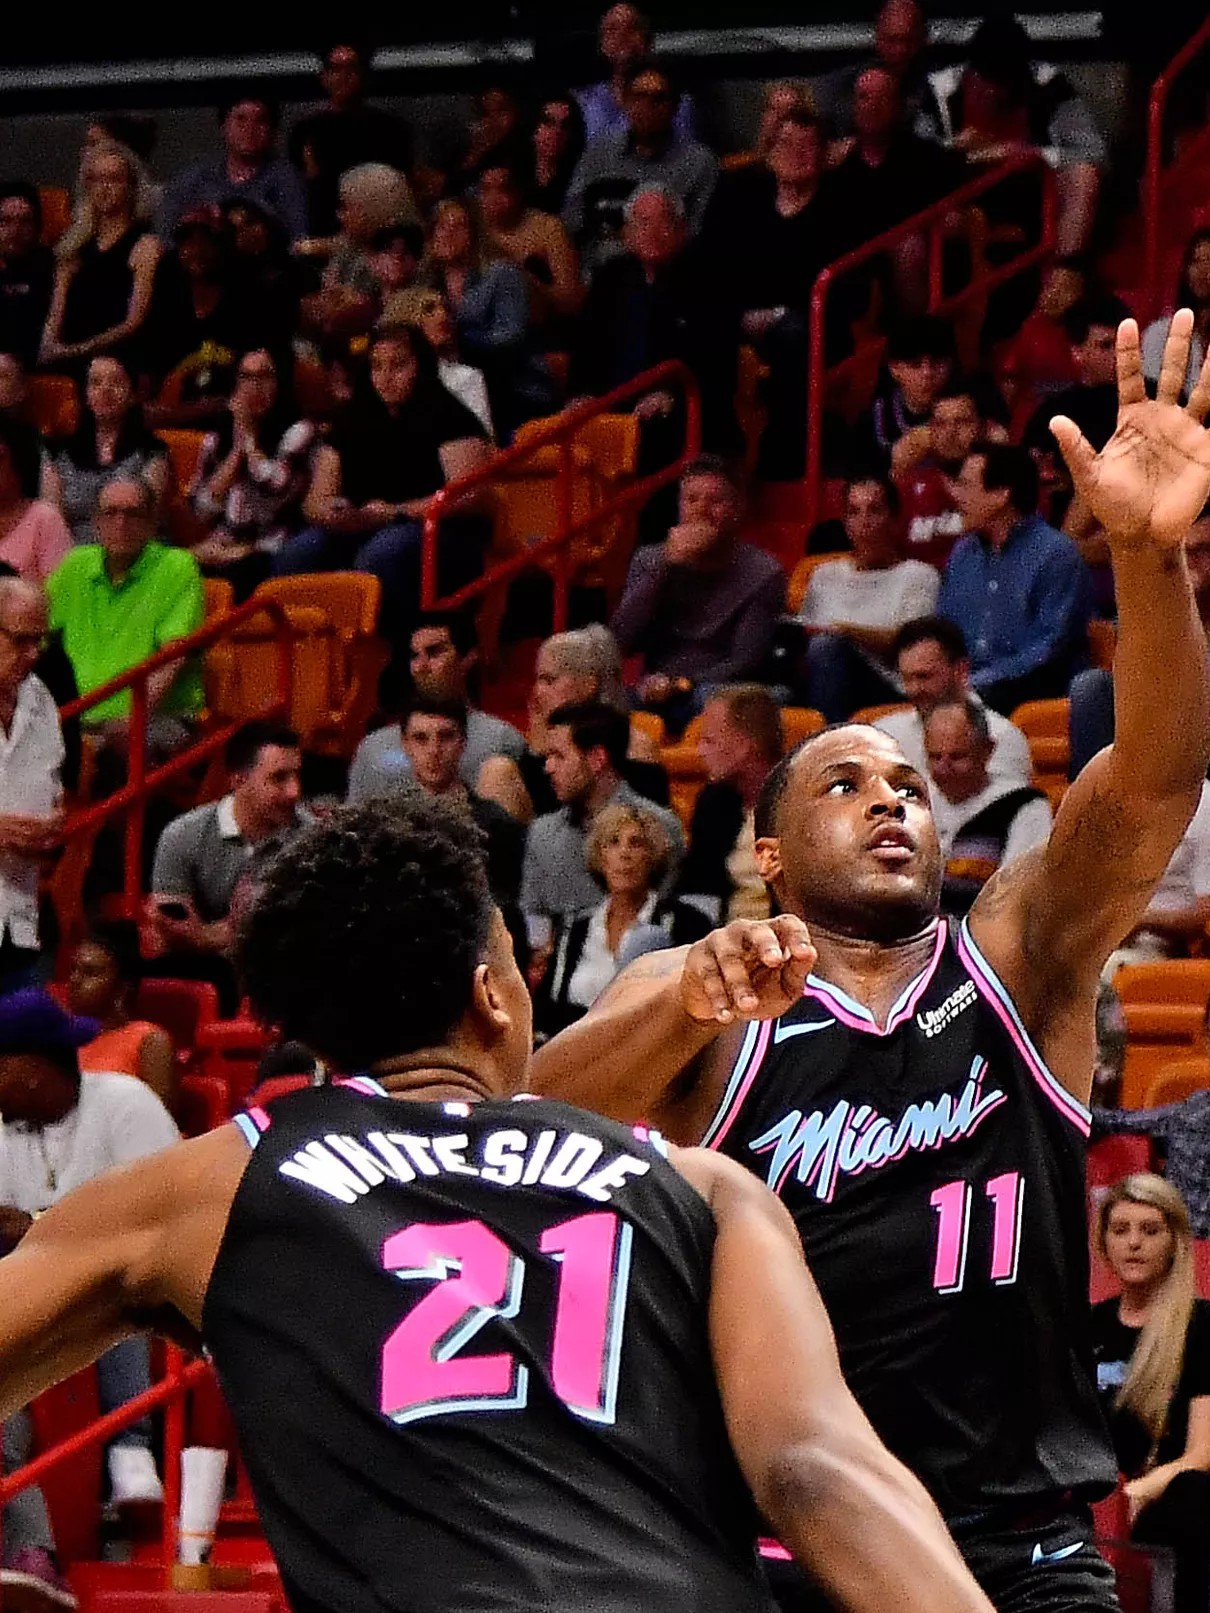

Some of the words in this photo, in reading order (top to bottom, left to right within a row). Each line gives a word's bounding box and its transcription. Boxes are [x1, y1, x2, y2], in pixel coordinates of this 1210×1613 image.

[917, 980, 975, 1029] Ultimate
[279, 1130, 650, 1204] WHITESIDE
[749, 1055, 1006, 1202] Miami
[930, 1172, 1025, 1294] 11
[381, 1211, 633, 1425] 21
